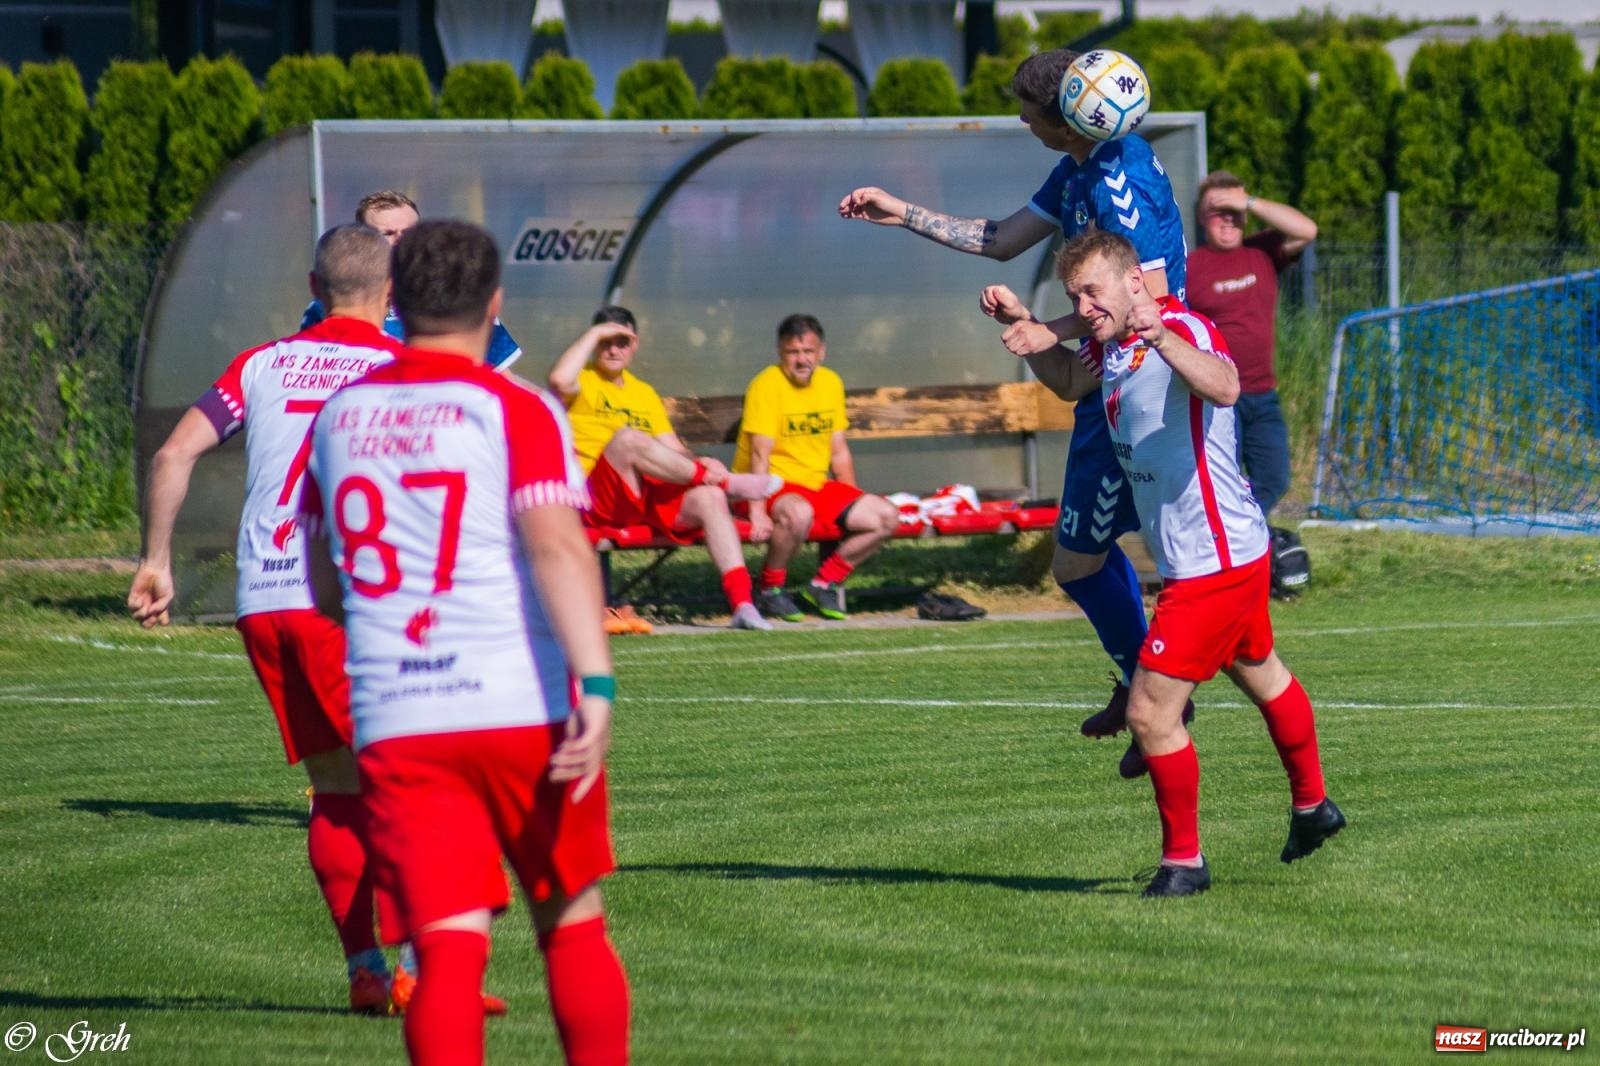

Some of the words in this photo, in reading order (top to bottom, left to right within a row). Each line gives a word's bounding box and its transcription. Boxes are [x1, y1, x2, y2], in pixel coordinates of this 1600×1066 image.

[514, 220, 626, 262] GOŚCIE
[271, 354, 296, 369] LKS
[300, 355, 377, 376] ZAMECZEK
[282, 371, 350, 389] CZERNICA
[276, 400, 327, 506] 7
[333, 472, 467, 600] 87
[1061, 506, 1079, 537] 21
